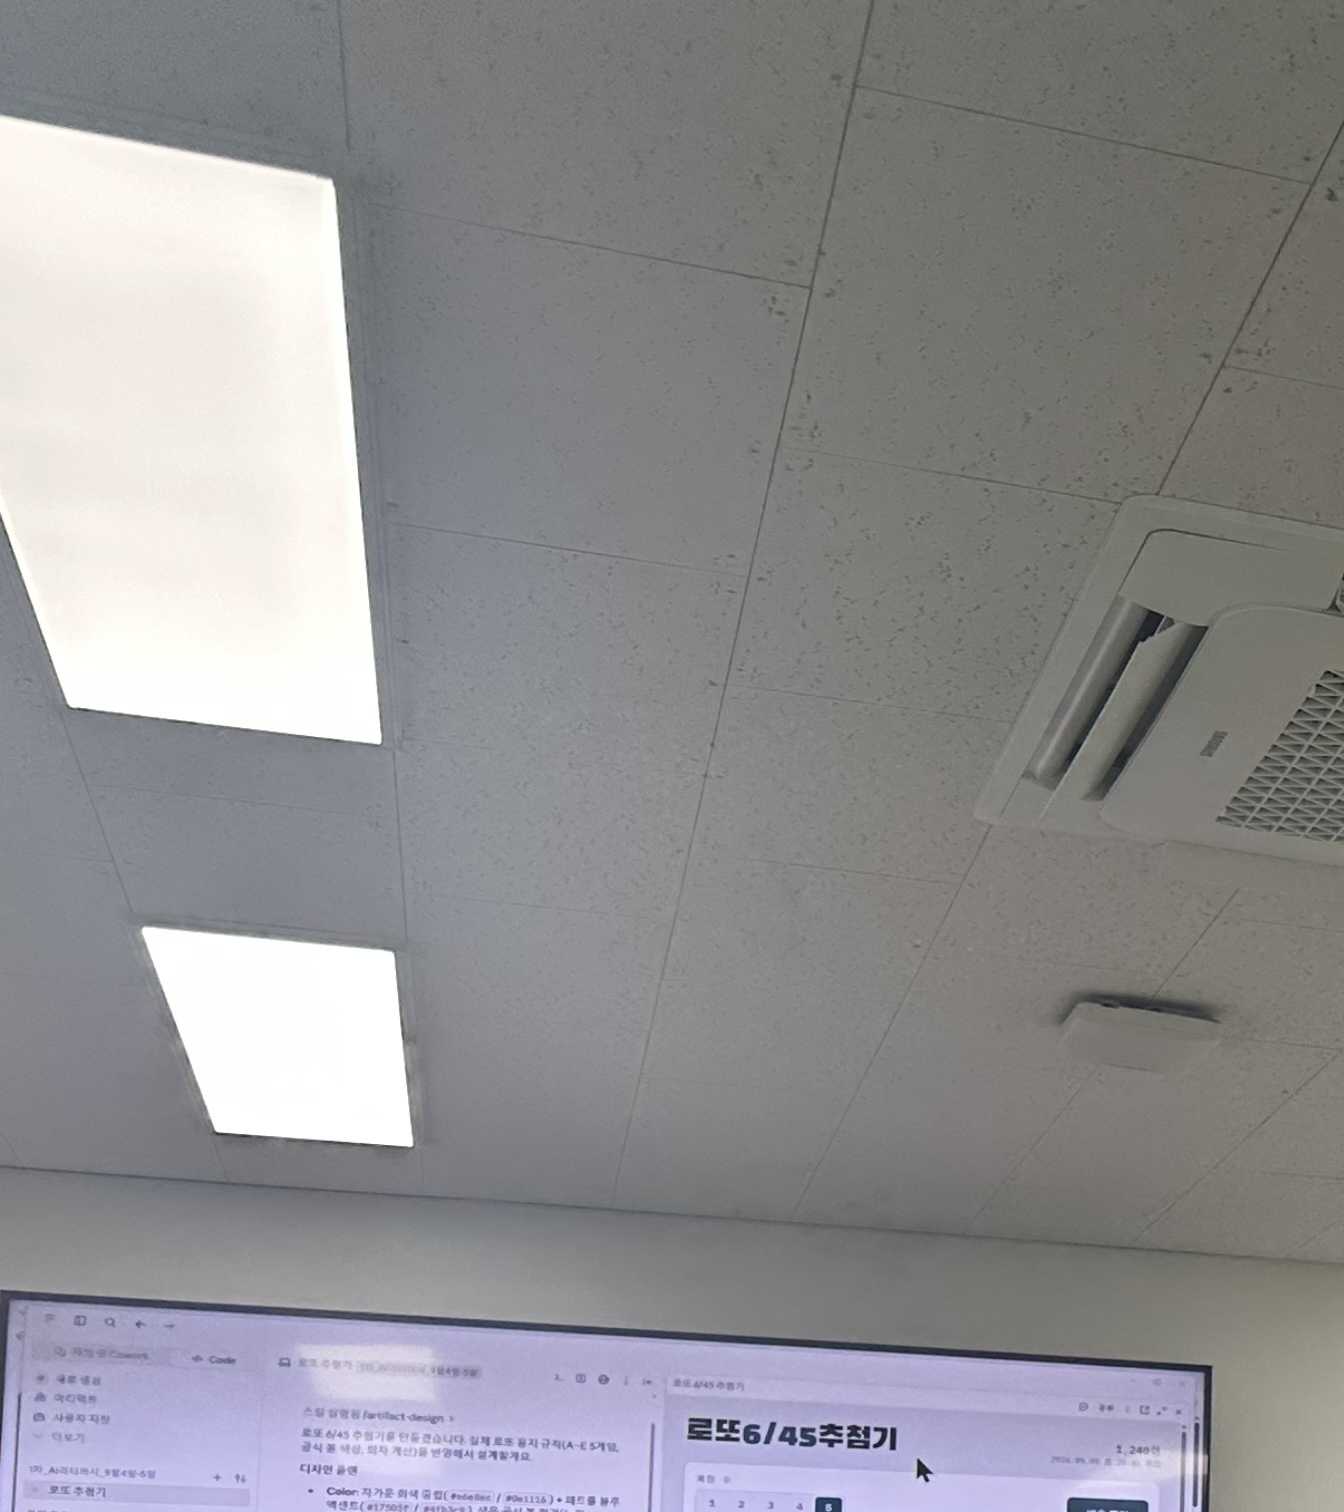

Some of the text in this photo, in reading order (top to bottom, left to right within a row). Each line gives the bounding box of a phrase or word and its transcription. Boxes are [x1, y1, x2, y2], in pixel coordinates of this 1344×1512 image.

[302, 1428, 323, 1439] 로또
[326, 1430, 350, 1440] 6/45
[300, 1463, 333, 1475] 디자인
